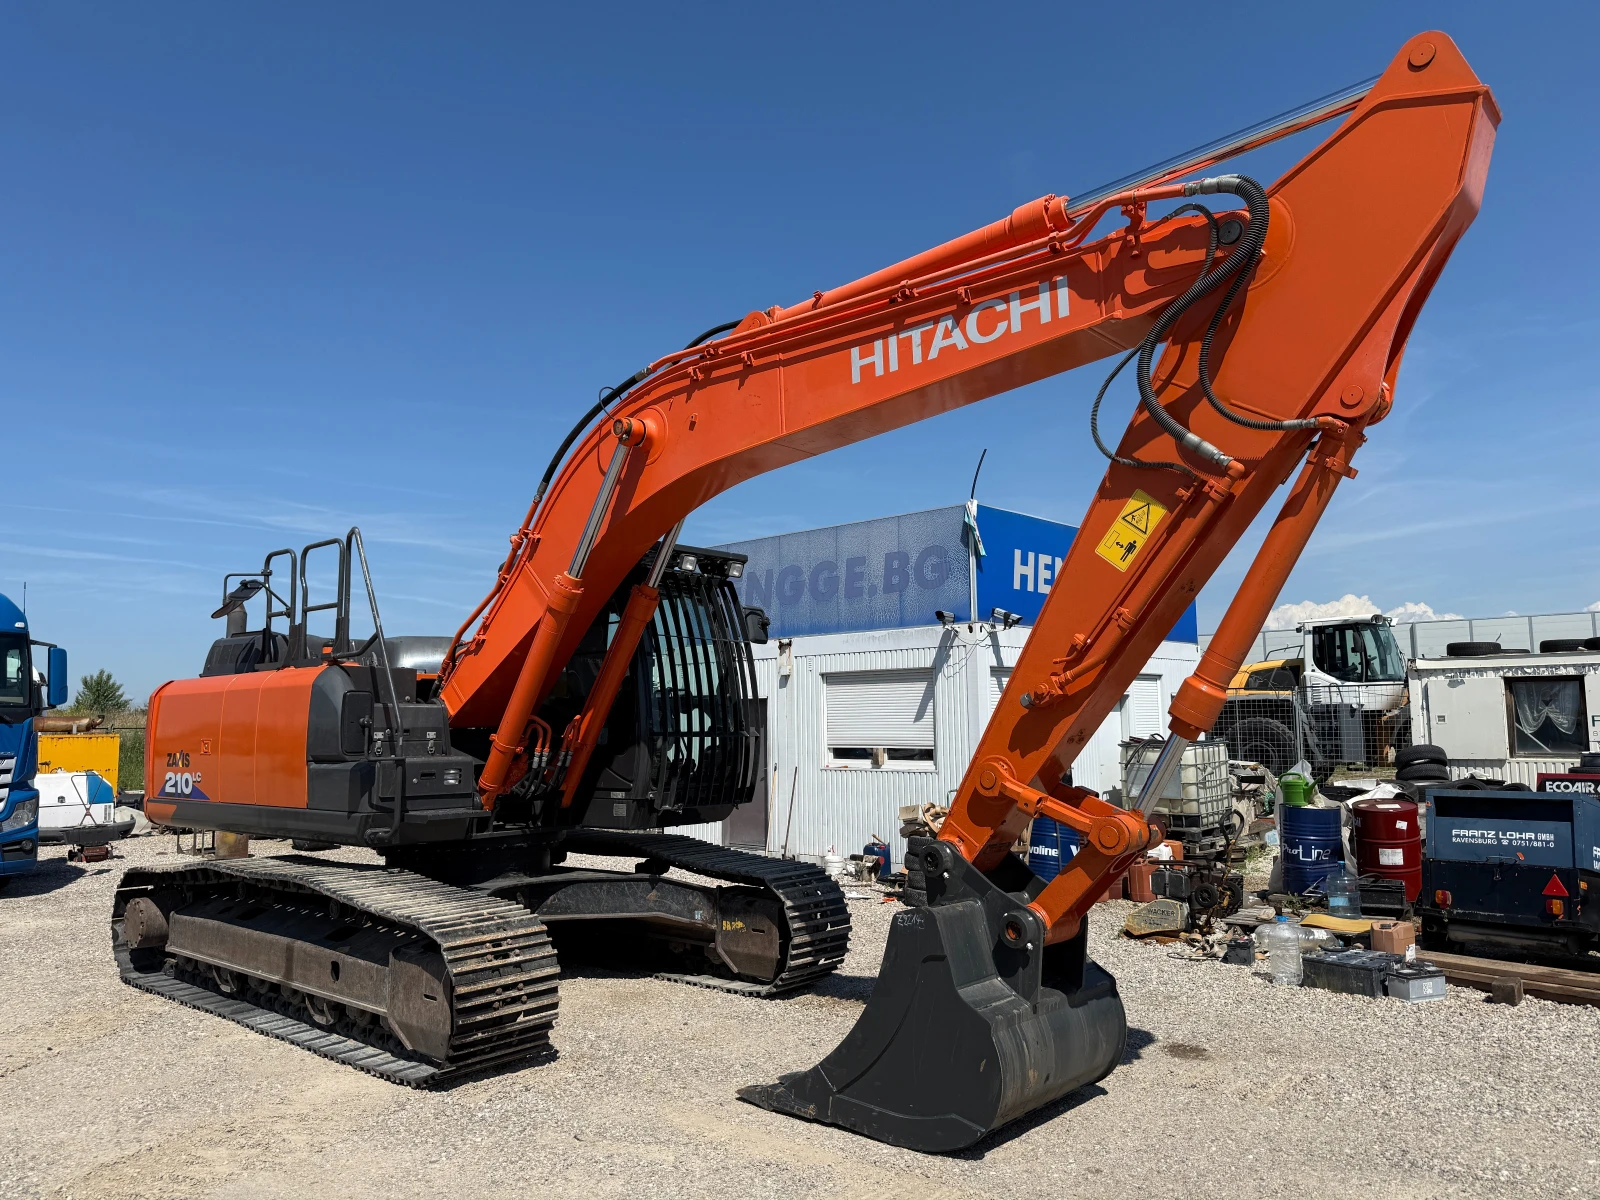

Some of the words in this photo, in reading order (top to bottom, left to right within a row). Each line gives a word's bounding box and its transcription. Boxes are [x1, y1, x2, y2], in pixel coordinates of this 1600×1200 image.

[851, 275, 1070, 385] HITACHI
[167, 750, 190, 767] ZAXIS
[1545, 781, 1595, 794] ECOAIR
[1452, 829, 1496, 838] FRANZ
[1499, 831, 1535, 840] LOHR
[1537, 833, 1555, 841] GMBH
[1452, 837, 1498, 845] RAVENSBURG
[1512, 840, 1555, 848] 0751/881-0
[1147, 907, 1175, 917] WACKER
